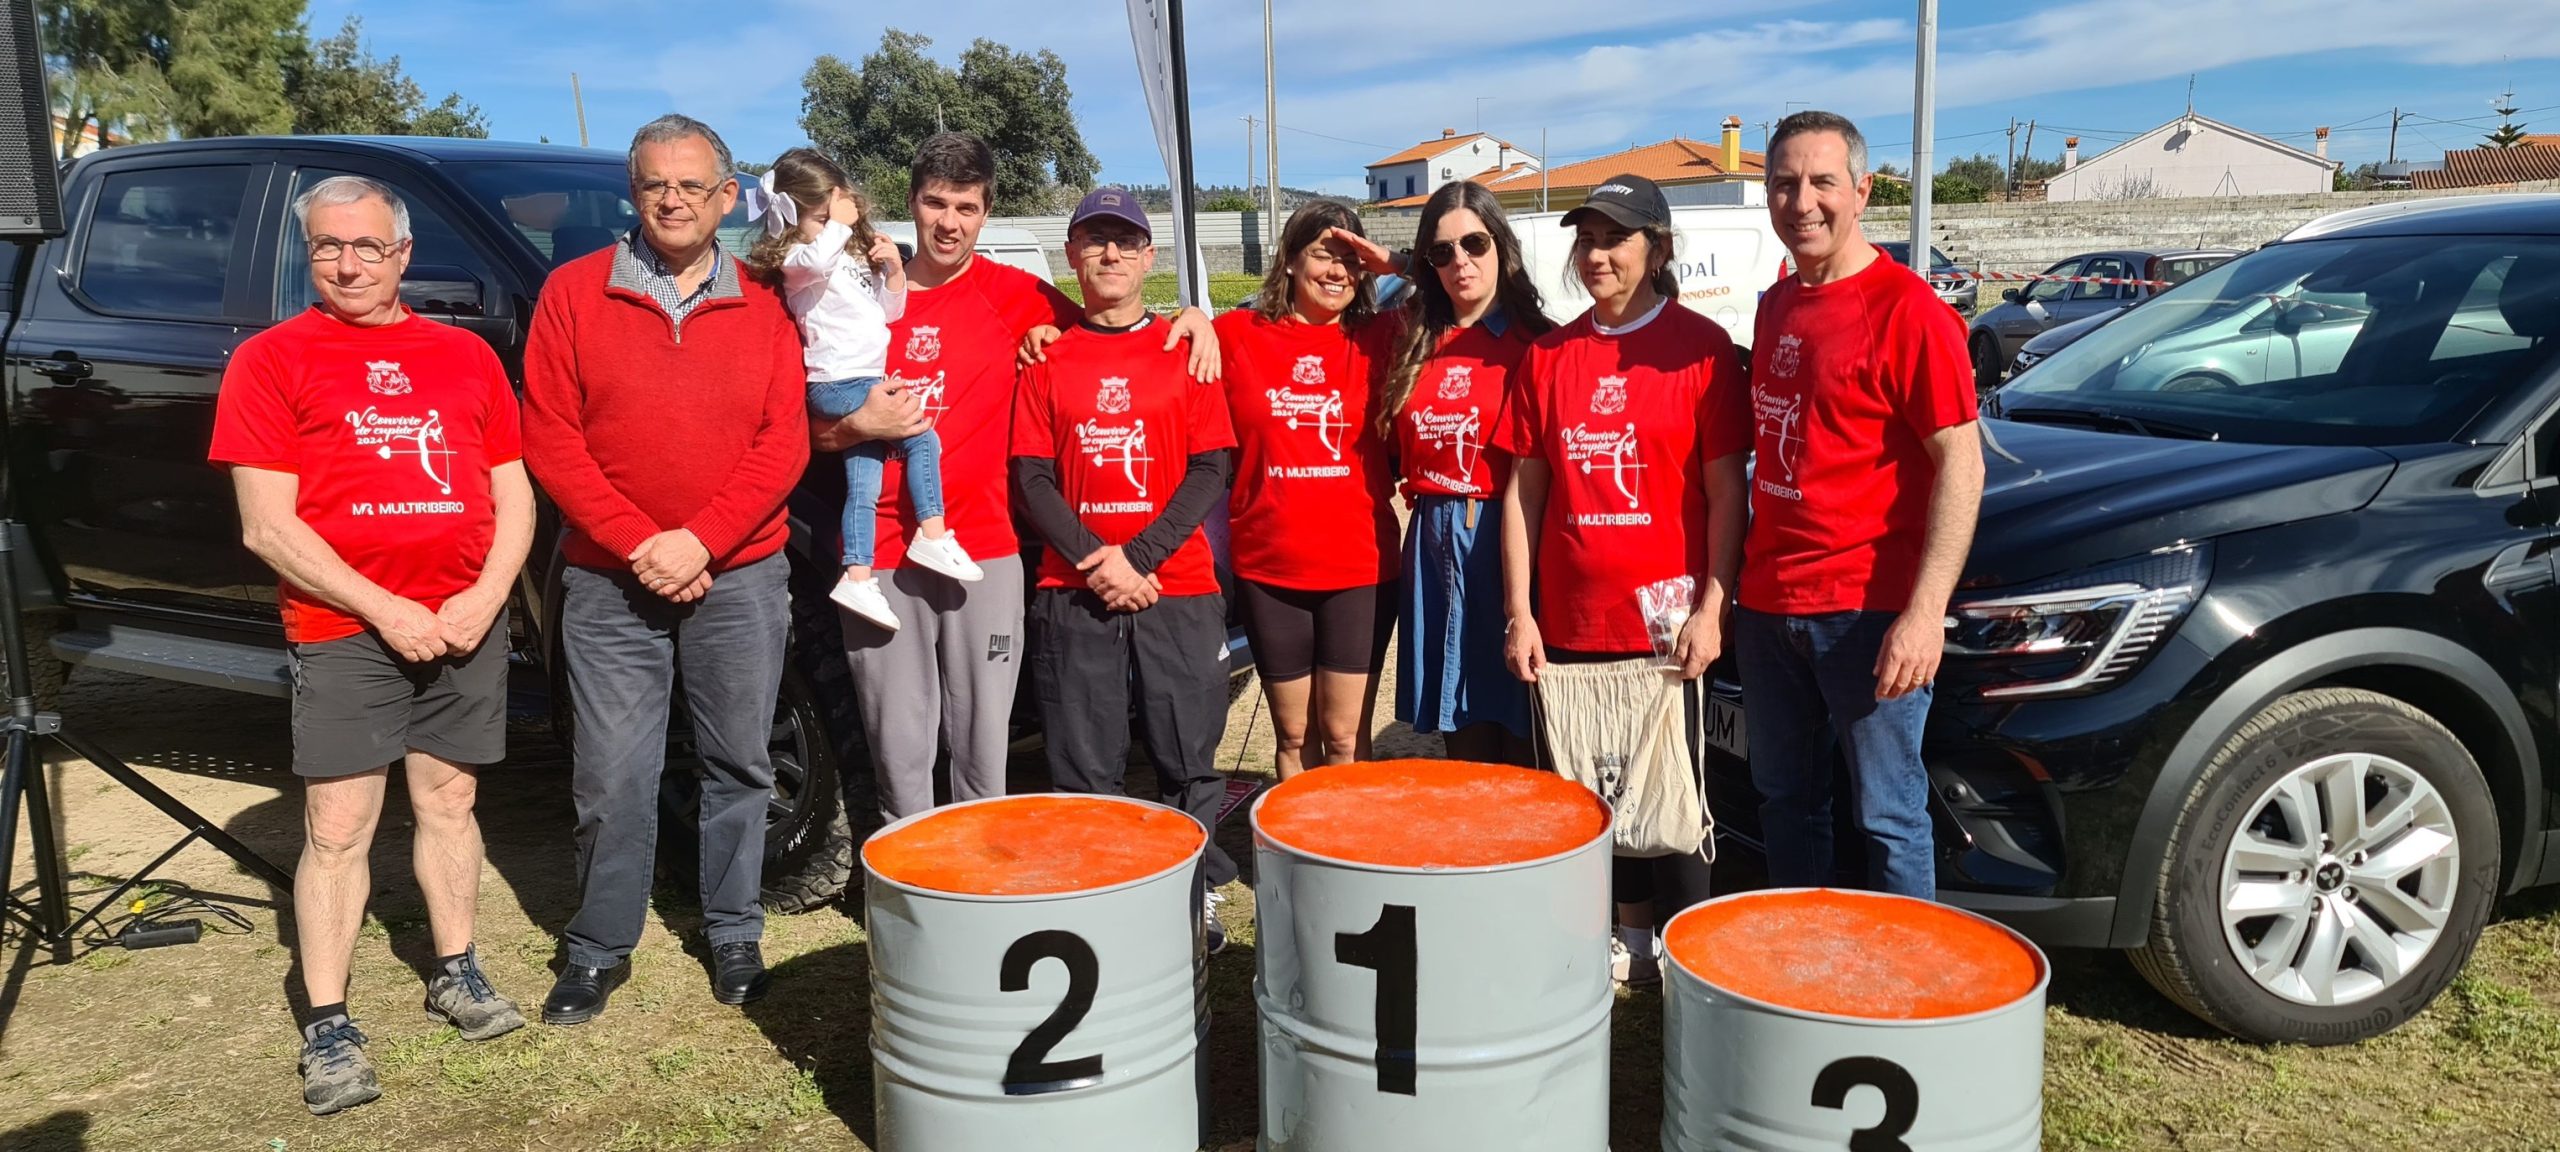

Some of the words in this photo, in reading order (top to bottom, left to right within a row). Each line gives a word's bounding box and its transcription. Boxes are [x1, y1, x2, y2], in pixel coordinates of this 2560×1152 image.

[1679, 286, 1730, 301] NNOSCO
[345, 406, 376, 428] V
[356, 437, 384, 446] 2024
[379, 501, 465, 515] MULTIRIBEIRO
[1579, 512, 1652, 526] MULTIRIBEIRO
[2201, 764, 2265, 850] EcoContact
[2265, 754, 2277, 768] 6
[1334, 903, 1417, 1097] 1
[1000, 929, 1103, 1095] 2
[1811, 1056, 1919, 1152] 3
